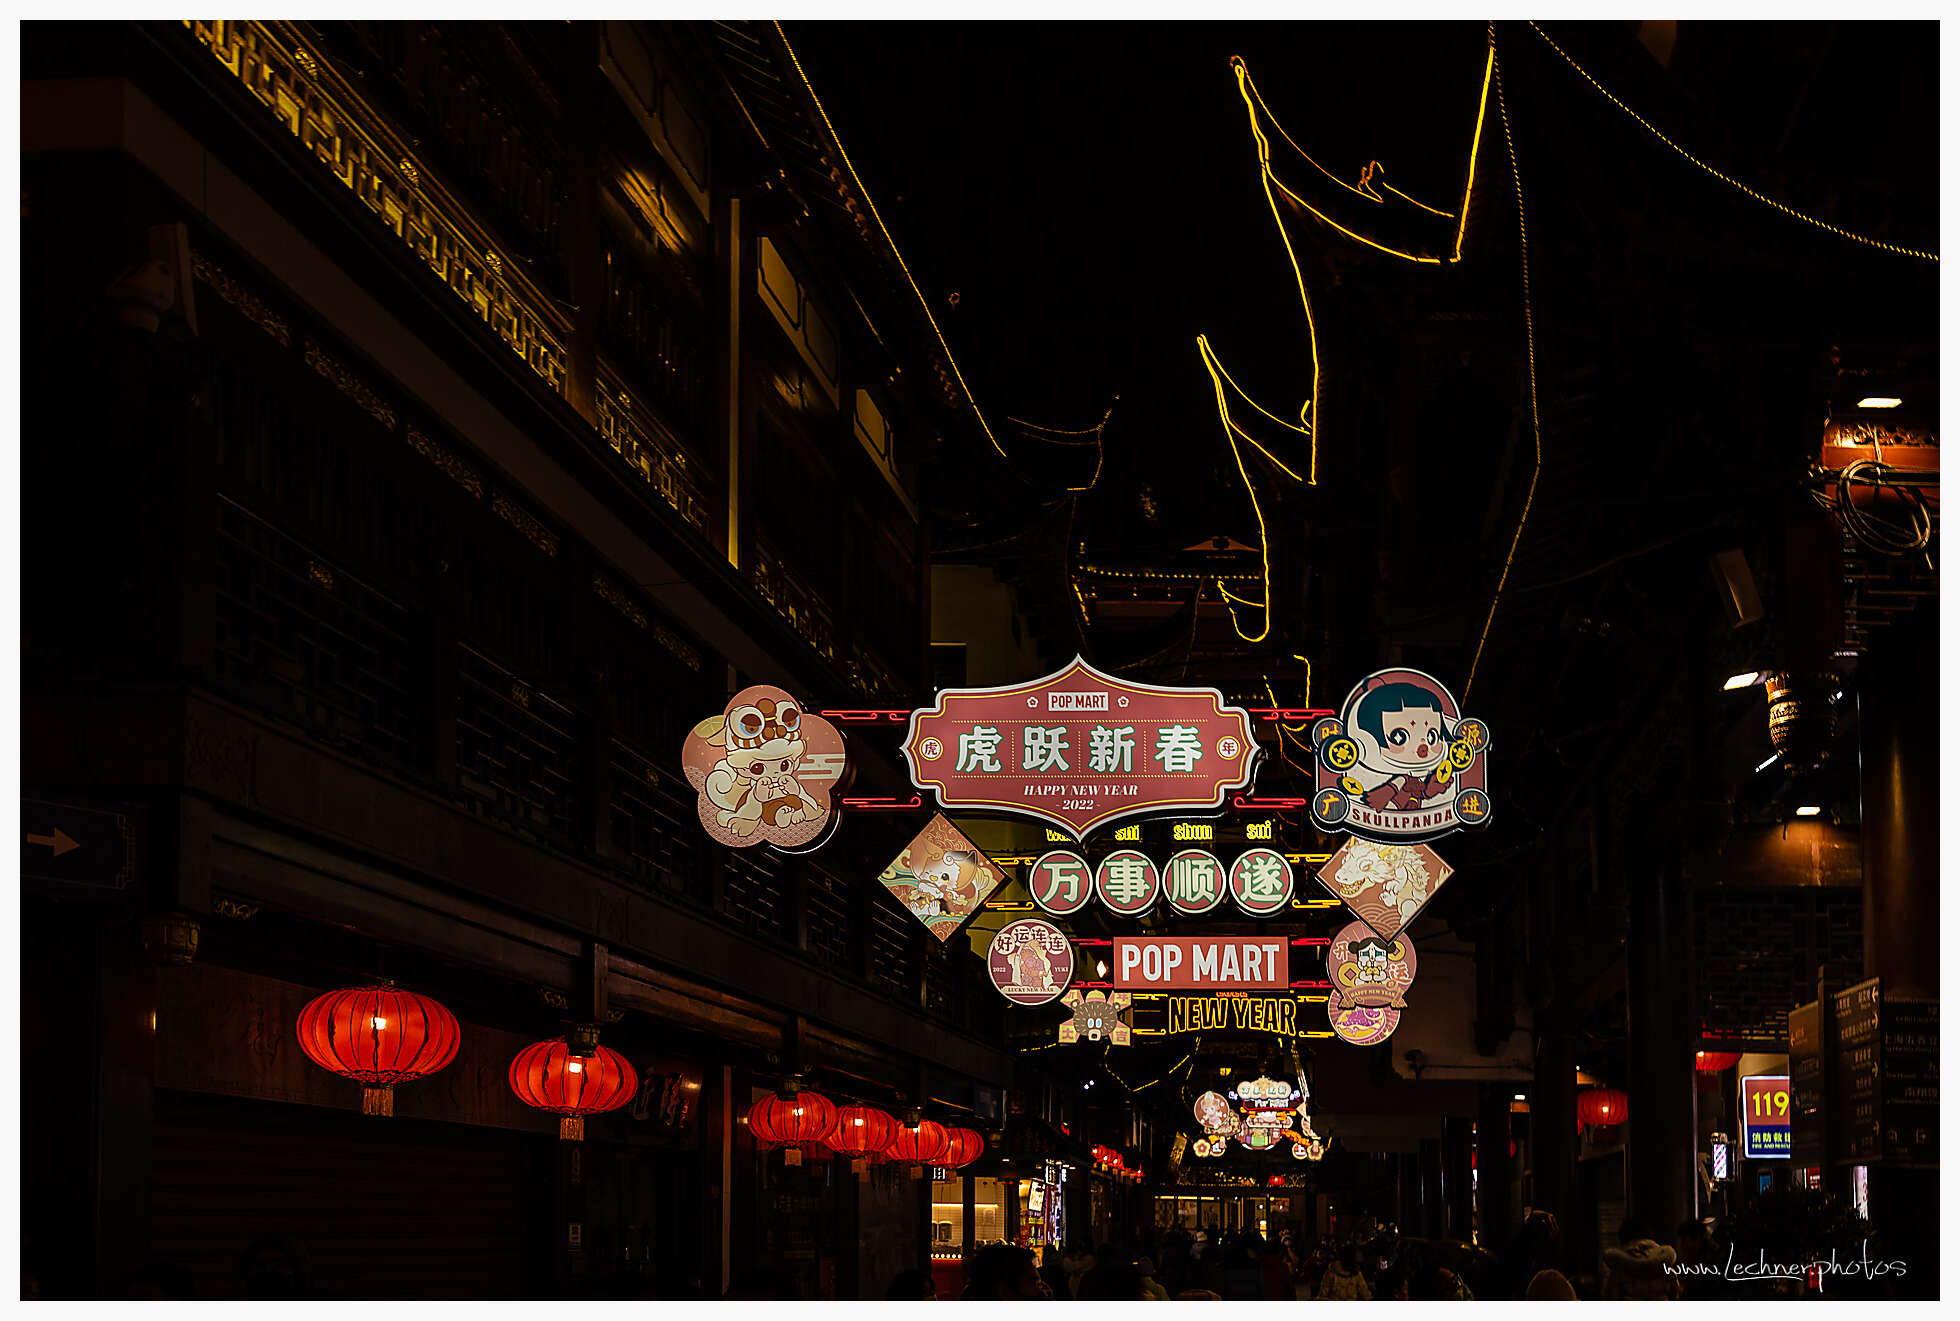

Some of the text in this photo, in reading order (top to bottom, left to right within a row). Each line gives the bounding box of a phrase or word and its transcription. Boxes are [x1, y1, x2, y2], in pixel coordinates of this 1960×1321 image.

[1051, 695, 1105, 708] POP MART
[955, 725, 1203, 773] 虎跃新春
[1221, 741, 1236, 756] 年
[1023, 785, 1138, 796] HAPPY NEW YEAR
[1062, 799, 1094, 810] 2022
[1322, 793, 1340, 816] 广
[1462, 794, 1483, 815] 进
[1352, 808, 1453, 828] SKULLPANDA
[1173, 823, 1213, 840] shun
[1247, 820, 1272, 840] sui
[1042, 855, 1284, 903] 万事顺遂
[996, 928, 1064, 952] 好运连连
[1121, 944, 1279, 982] POP MART
[1168, 997, 1296, 1036] NEW YEAR
[1753, 1091, 1789, 1116] 119
